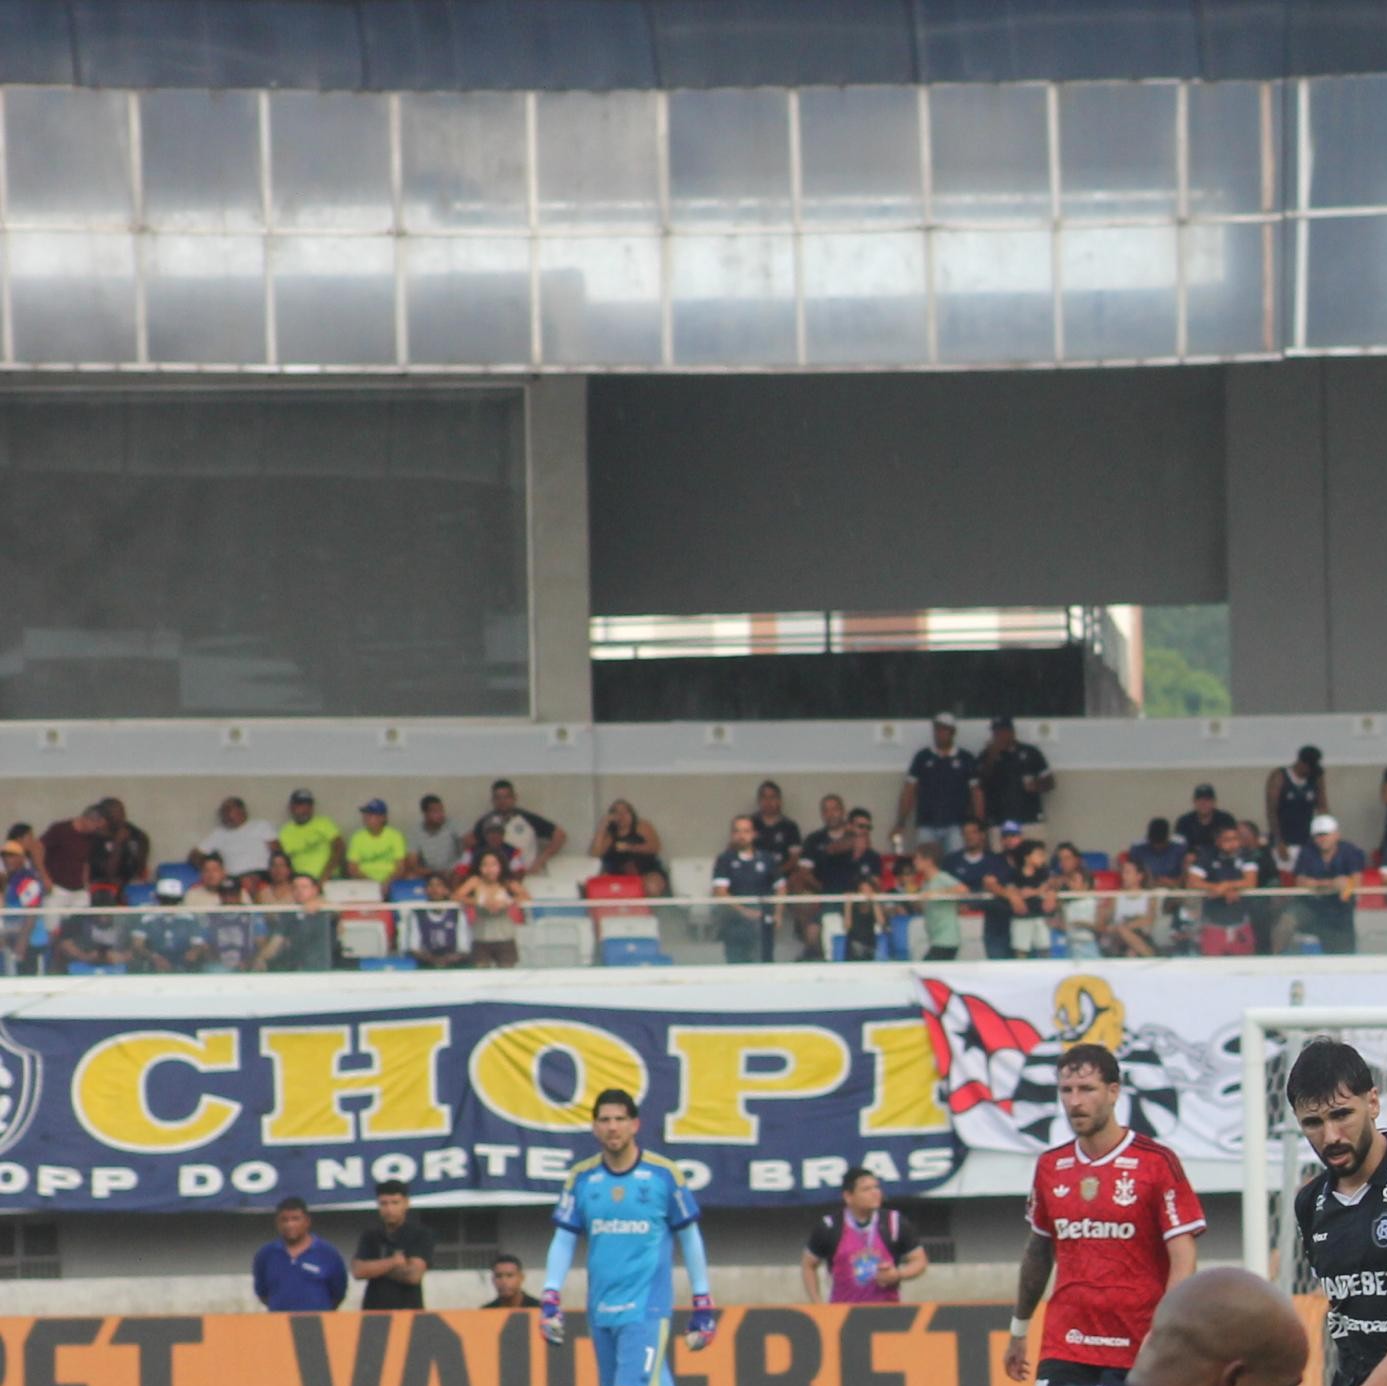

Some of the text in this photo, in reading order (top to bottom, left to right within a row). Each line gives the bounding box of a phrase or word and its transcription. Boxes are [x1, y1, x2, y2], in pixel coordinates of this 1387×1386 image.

[178, 1161, 279, 1198] DO
[316, 1144, 577, 1191] NORTE
[1054, 1218, 1136, 1240] Betano
[643, 1347, 655, 1373] 1
